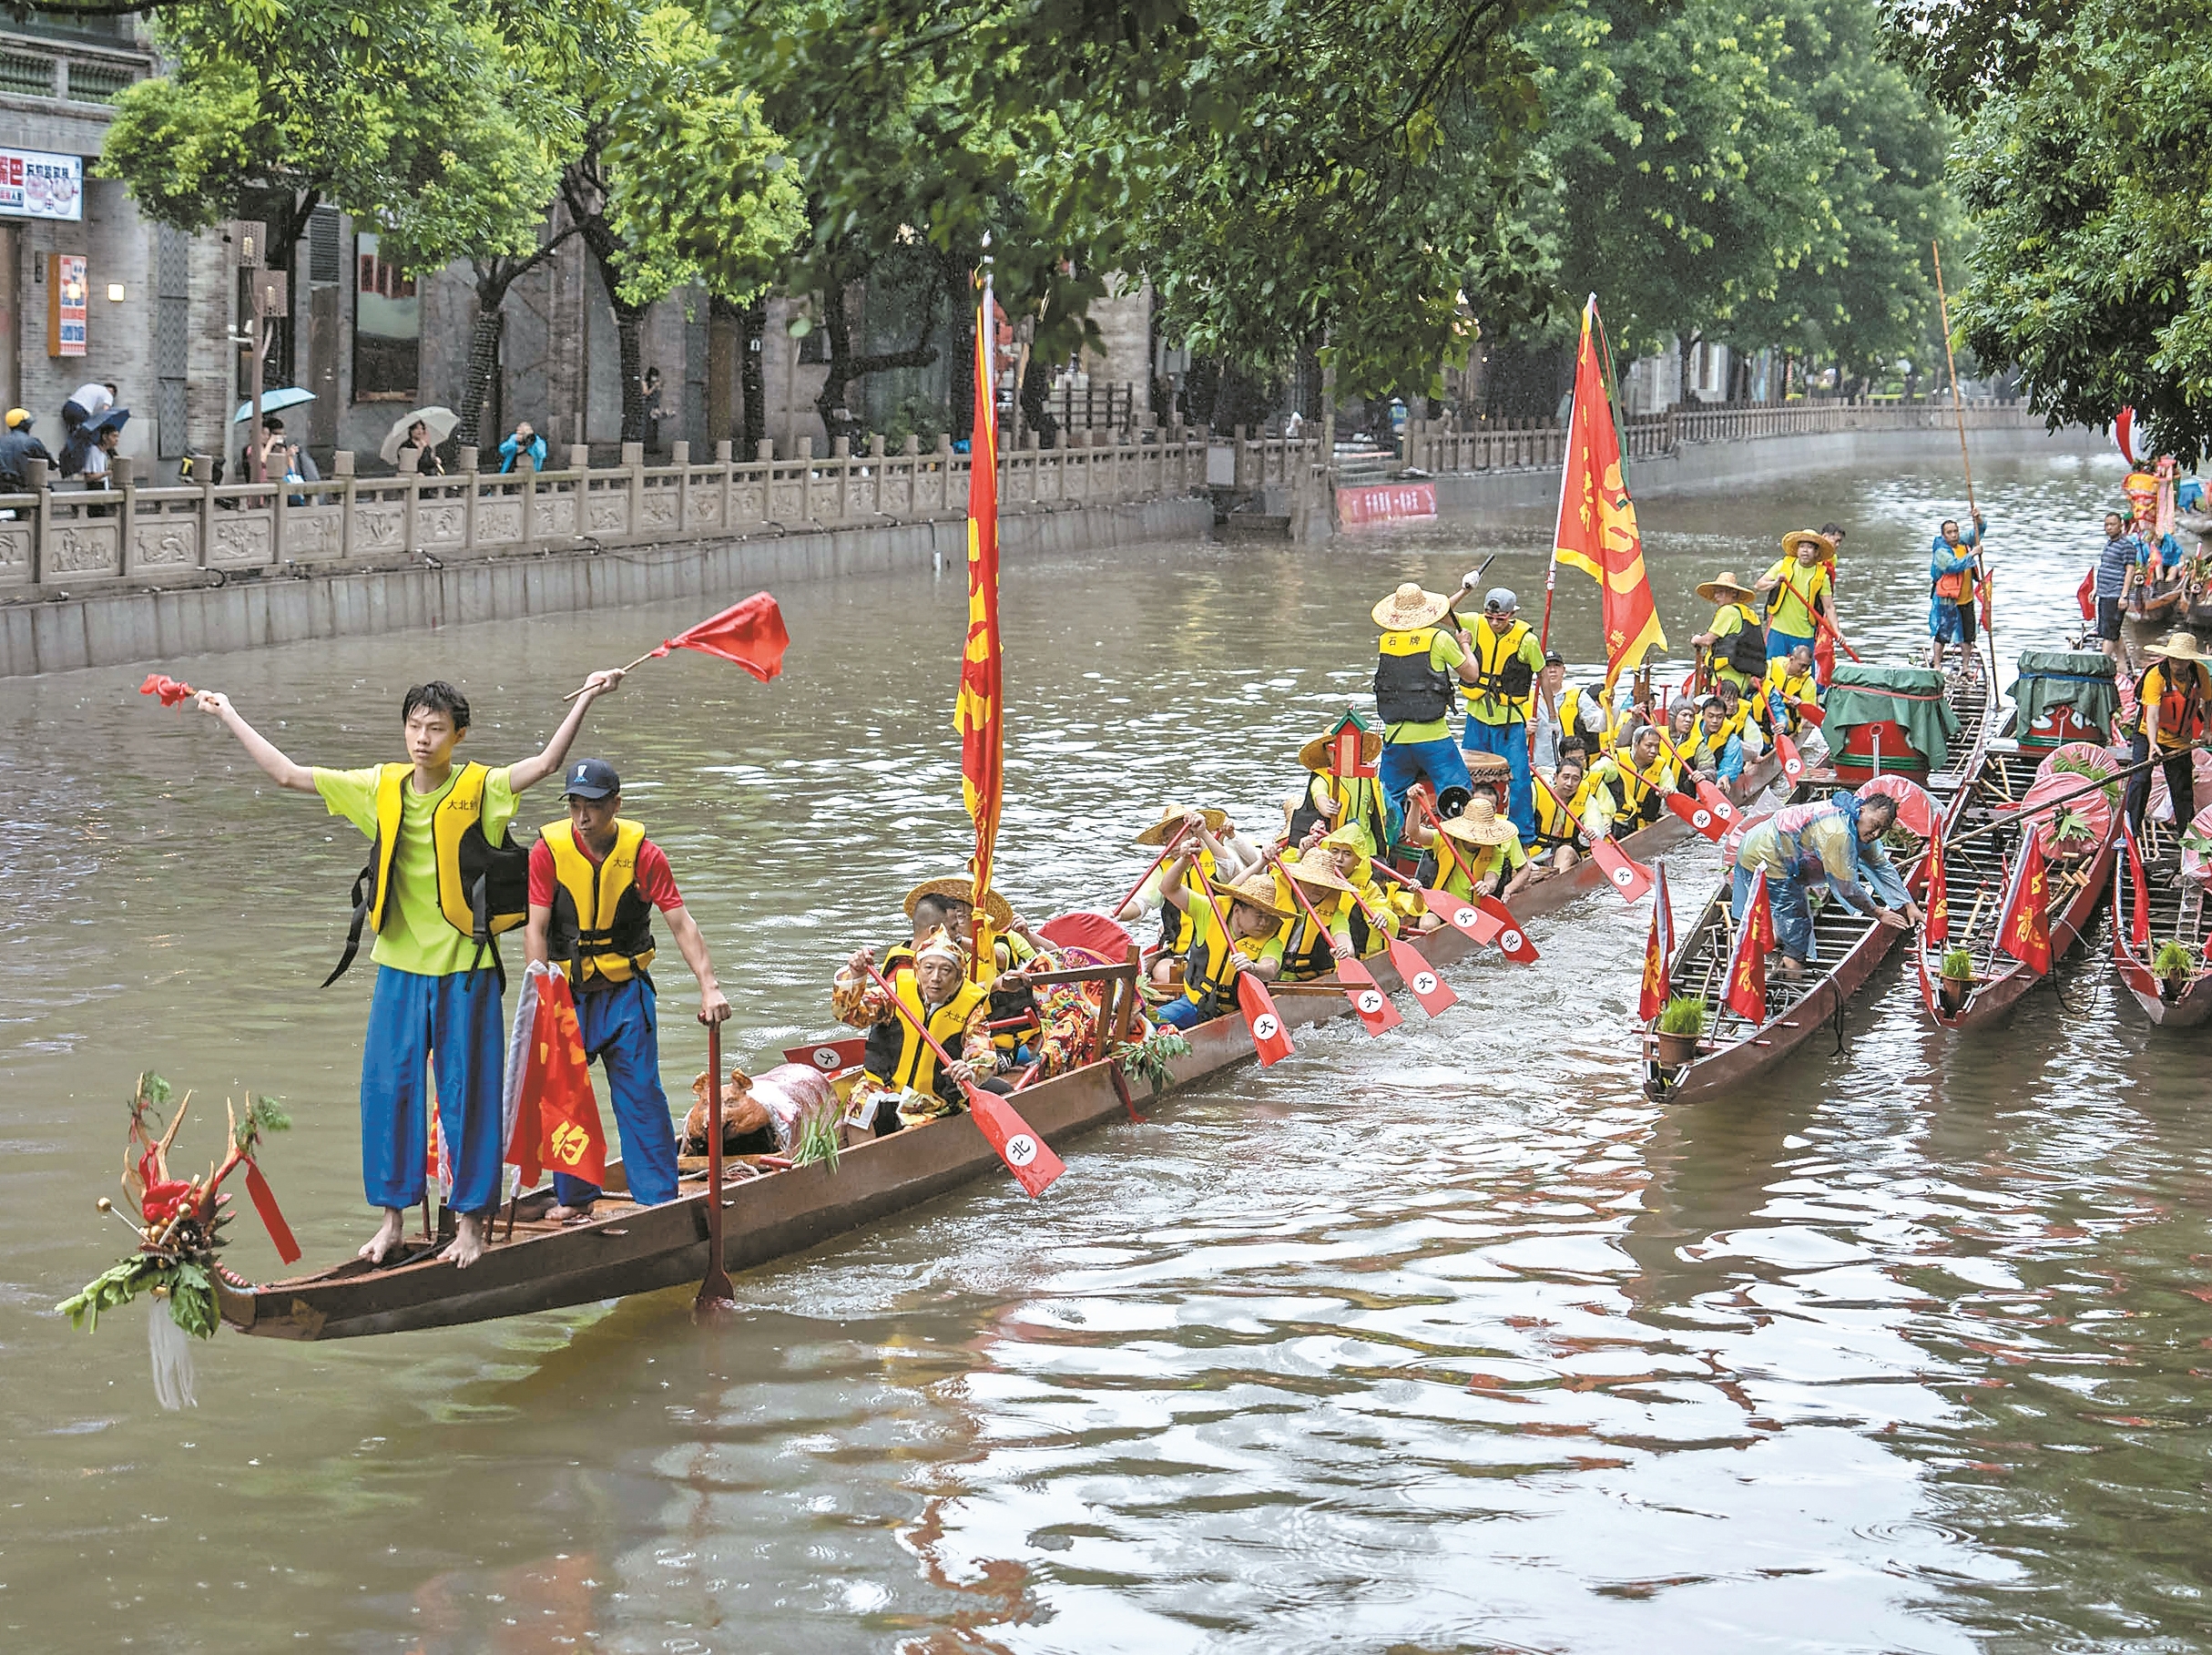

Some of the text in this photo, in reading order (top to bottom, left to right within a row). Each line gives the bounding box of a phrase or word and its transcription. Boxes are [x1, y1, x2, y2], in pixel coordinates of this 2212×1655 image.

[613, 856, 634, 869] 大北
[1505, 935, 1519, 946] 北
[1419, 976, 1433, 989] 大
[1364, 996, 1379, 1008] 大
[1260, 1020, 1274, 1034] 大
[819, 1052, 834, 1066] 大
[1012, 1139, 1031, 1160] 北
